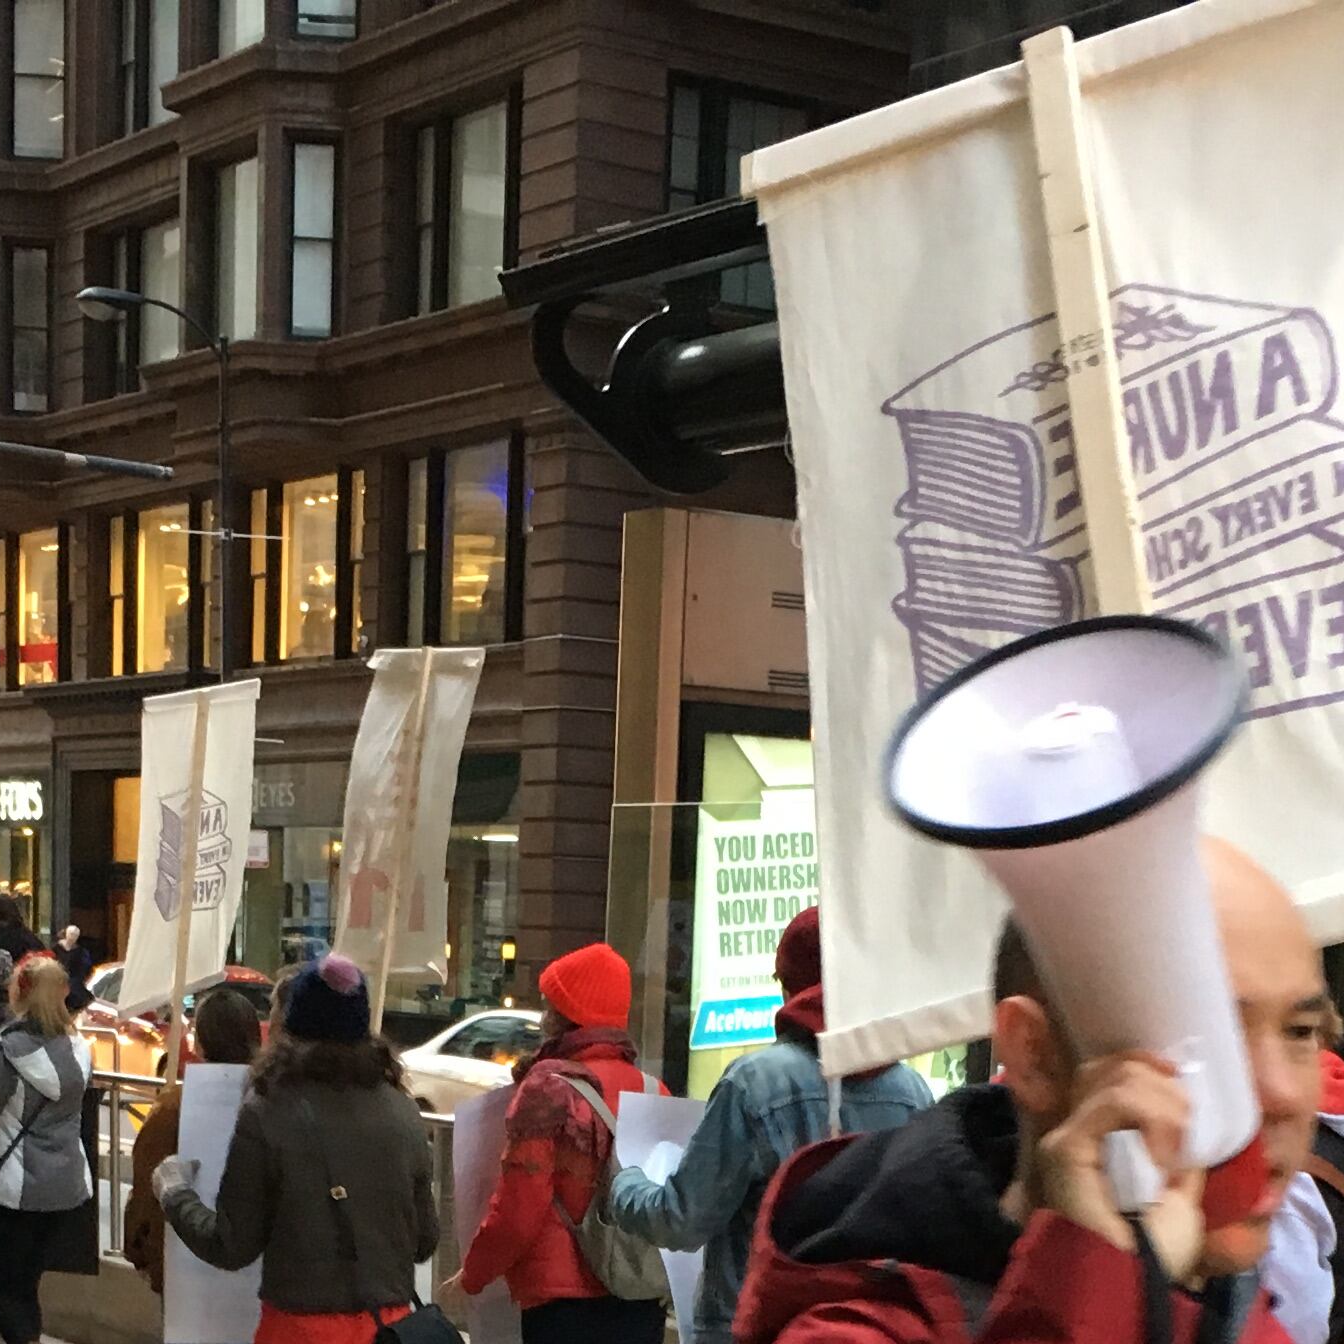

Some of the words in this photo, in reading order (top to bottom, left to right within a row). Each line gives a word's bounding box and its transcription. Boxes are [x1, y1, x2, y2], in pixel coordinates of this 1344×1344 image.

[714, 835, 756, 863] YOU
[762, 832, 814, 860] ACED
[716, 863, 819, 895] OWNERSH
[718, 898, 767, 926] NOW
[773, 895, 801, 922] DO
[720, 928, 785, 958] RETIR
